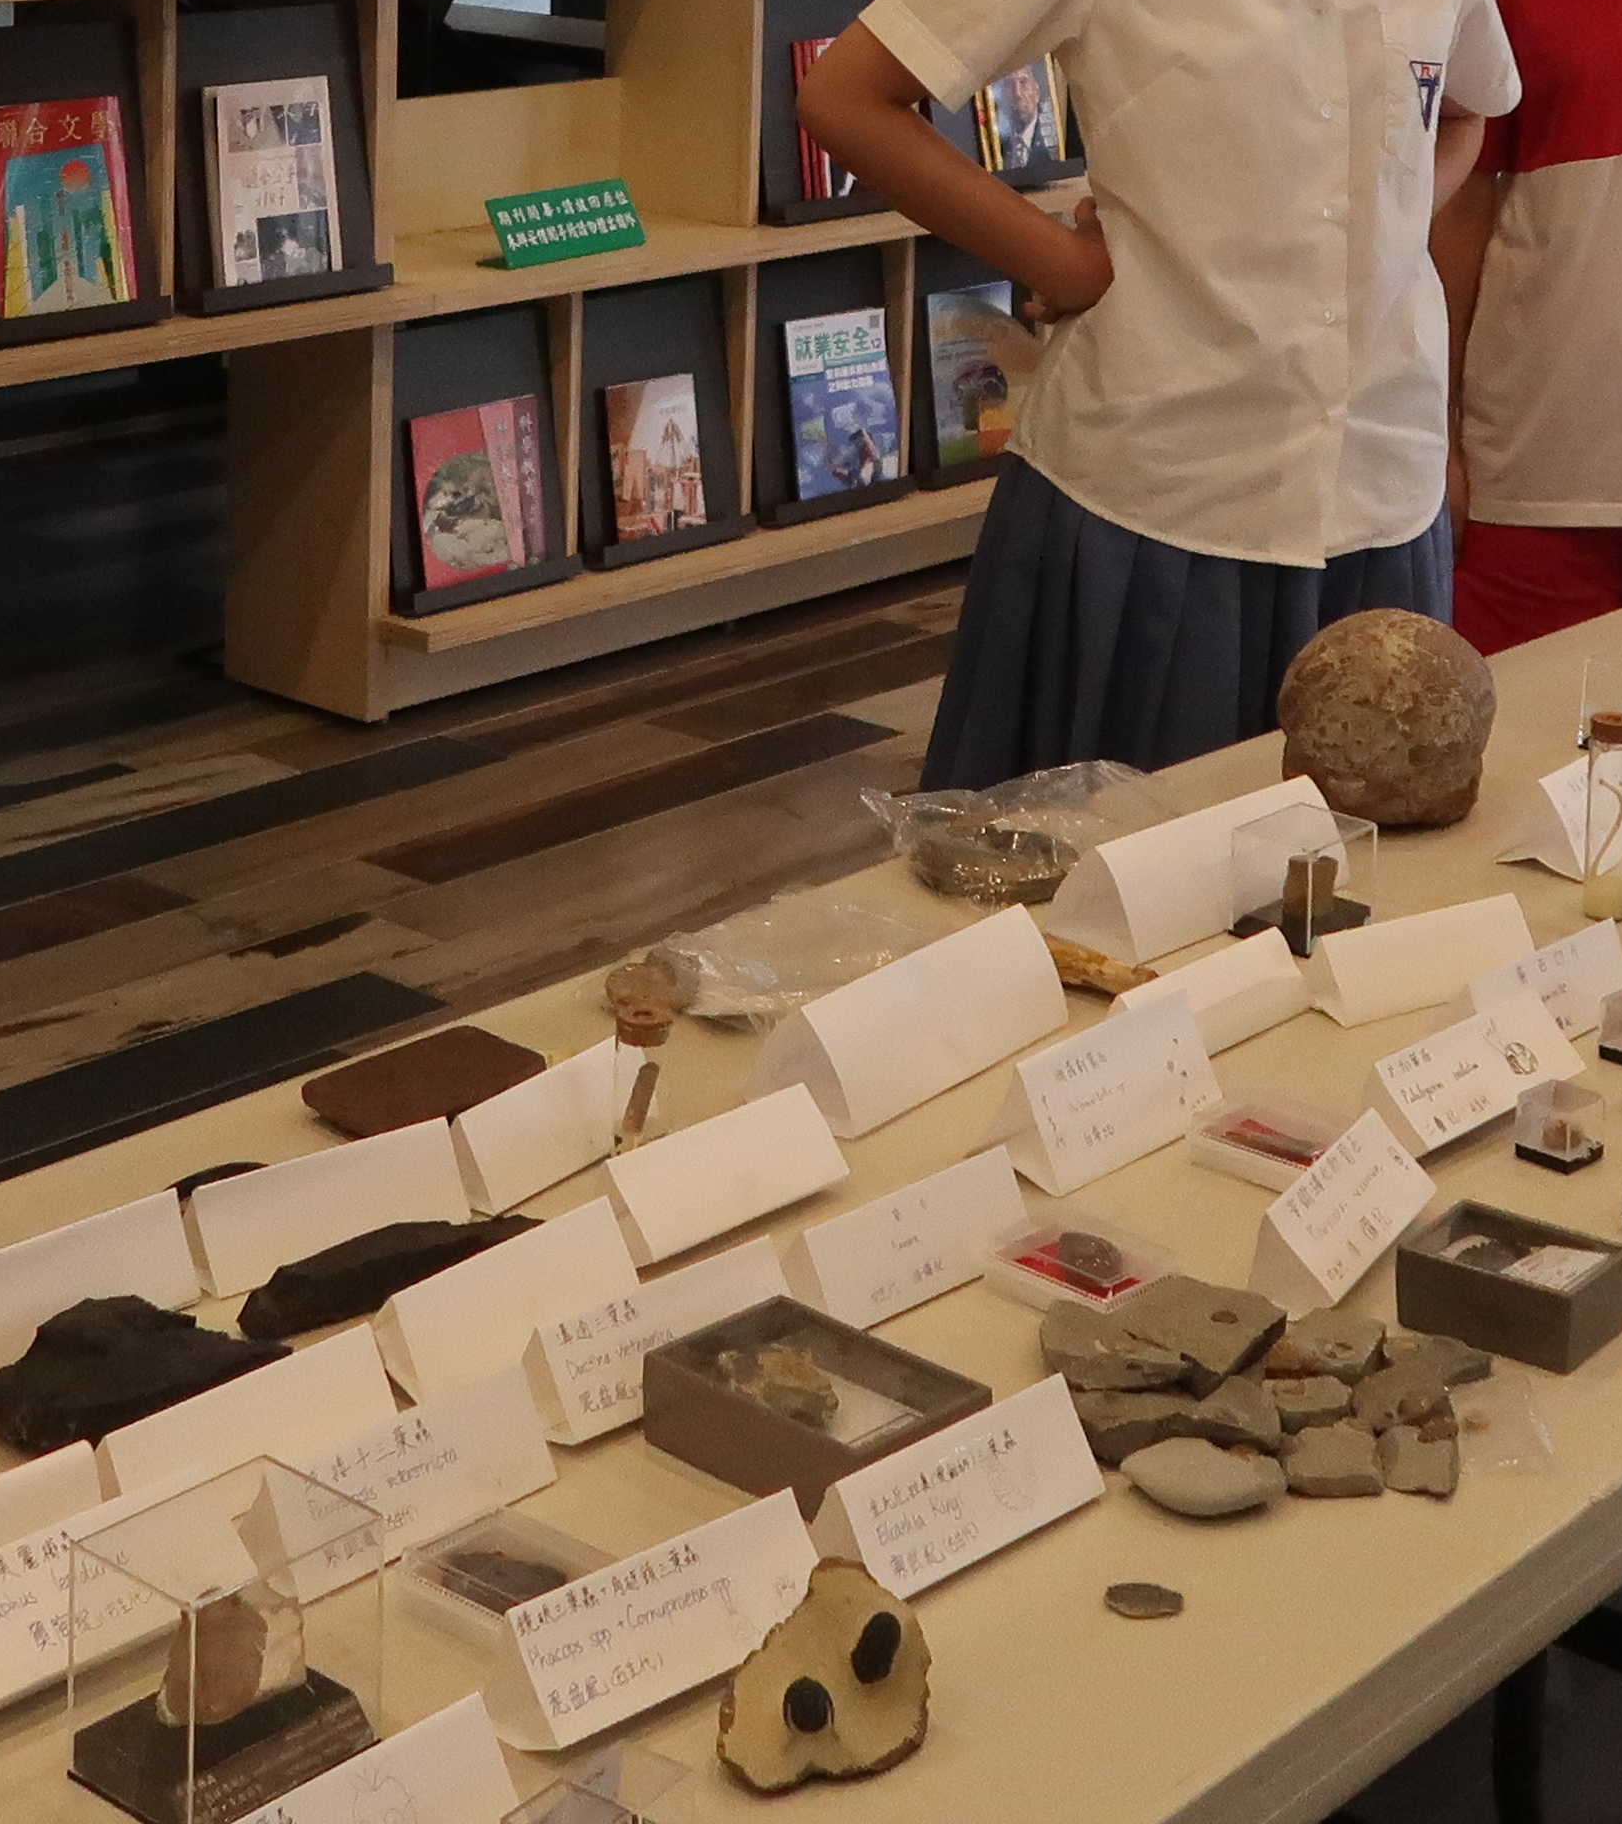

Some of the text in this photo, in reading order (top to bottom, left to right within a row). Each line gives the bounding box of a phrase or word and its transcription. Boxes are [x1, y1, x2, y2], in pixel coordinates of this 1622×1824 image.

[794, 327, 871, 362] 就業安全
[529, 1641, 584, 1669] Phacops
